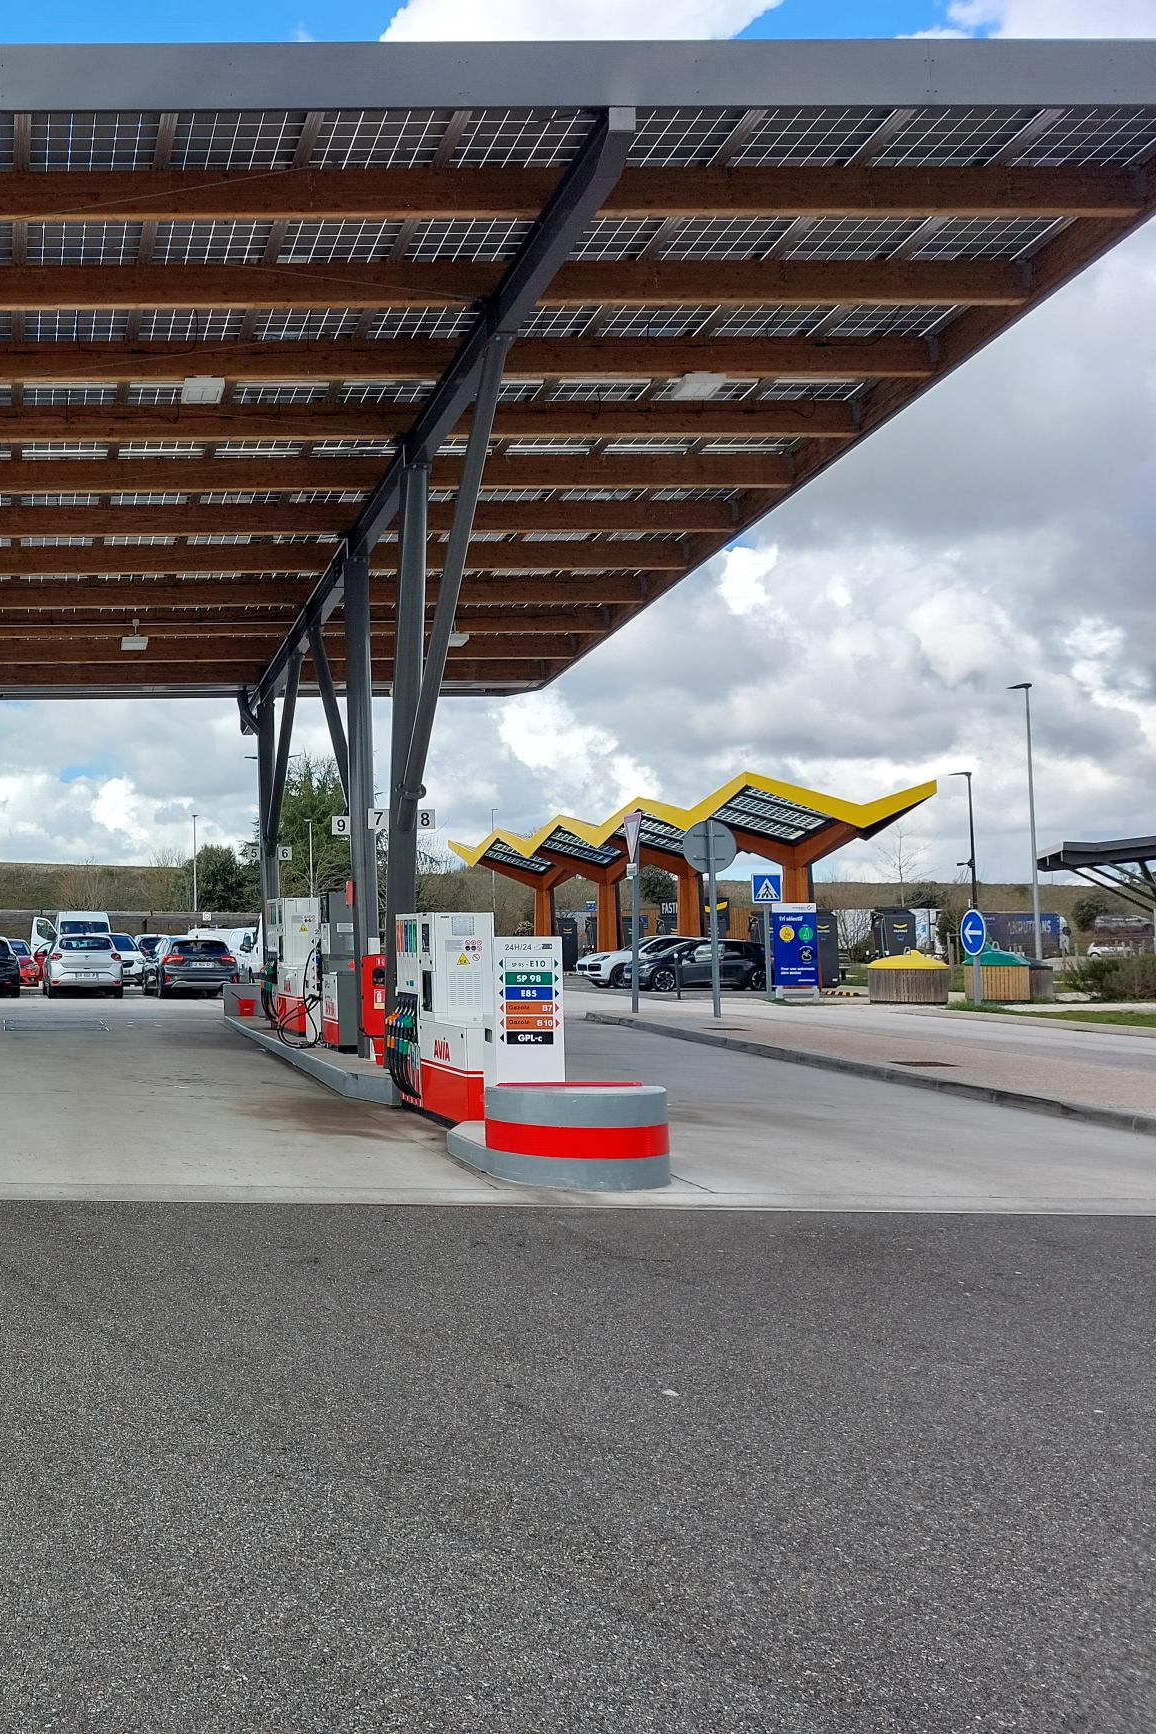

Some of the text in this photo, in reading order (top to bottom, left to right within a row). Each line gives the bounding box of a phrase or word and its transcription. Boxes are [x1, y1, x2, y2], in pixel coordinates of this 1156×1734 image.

[374, 812, 383, 825] 7
[421, 813, 430, 826] 8
[337, 819, 346, 832] 9
[251, 848, 257, 857] 5
[282, 849, 288, 858] 6
